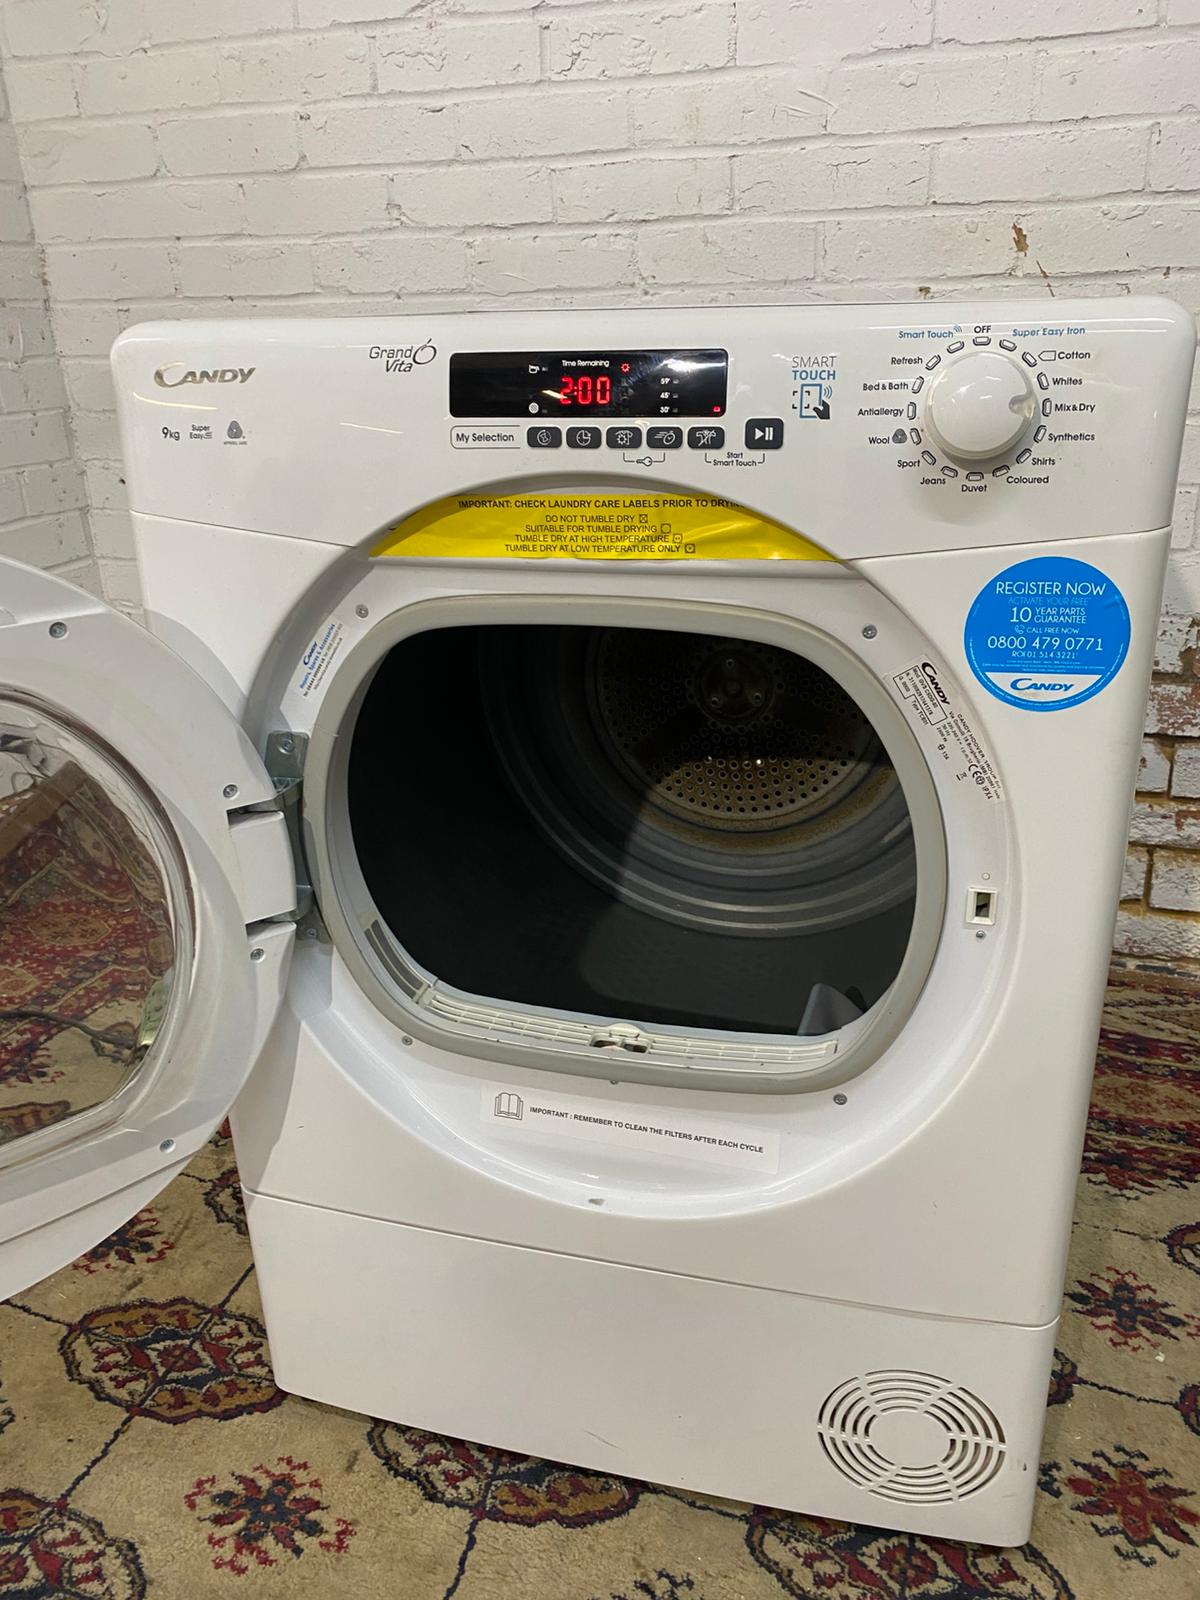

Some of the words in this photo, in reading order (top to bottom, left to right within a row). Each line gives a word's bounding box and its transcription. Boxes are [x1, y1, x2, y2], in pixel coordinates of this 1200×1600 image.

[898, 330, 925, 339] Smart
[927, 330, 953, 338] Touch
[974, 325, 991, 334] OFF
[1012, 328, 1040, 337] Super
[1042, 327, 1064, 337] Easy
[1067, 326, 1086, 335] Iron
[369, 346, 413, 359] Grand
[1057, 351, 1091, 360] Cotton
[386, 359, 413, 372] Vita
[577, 359, 609, 368] Remaining
[792, 355, 837, 368] SMART
[890, 356, 923, 365] Refresh
[154, 362, 256, 388] CANDY
[792, 370, 836, 380] TOUCH
[863, 382, 880, 391] Bed
[888, 381, 908, 390] Bath
[1052, 377, 1083, 386] Whites
[560, 376, 610, 405] 2:00
[857, 407, 905, 418] Antiallergy
[1054, 402, 1096, 413] Mix&Dry
[191, 424, 210, 432] Super
[162, 426, 181, 441] 9kg
[189, 431, 204, 440] Easy
[456, 433, 470, 444] My
[471, 432, 514, 443] Selection
[1048, 432, 1096, 442] Synthetics
[868, 436, 890, 445] Wool
[726, 451, 743, 459] Start
[712, 459, 734, 467] Smart
[735, 459, 757, 467] Touch
[897, 459, 921, 469] Sport
[1031, 457, 1056, 466] Shirts
[920, 476, 946, 486] Jeans
[1006, 475, 1049, 485] Coloured
[961, 484, 988, 493] Duvet
[458, 500, 513, 508] IMPORTANT:
[514, 499, 546, 508] CHECK
[548, 499, 592, 508] LAUNDRY
[594, 499, 620, 508] CARE
[622, 499, 660, 508] LABELS
[662, 499, 693, 508] PRIOR
[695, 499, 708, 507] TO
[545, 514, 559, 522] DO
[560, 514, 578, 523] NOT
[579, 514, 614, 523] TUMBLE
[616, 514, 635, 523] DRY
[525, 524, 564, 533] SUITABLE
[566, 524, 585, 533] FOR
[587, 524, 621, 533] TUMBLE
[623, 524, 658, 533] DRYING
[515, 534, 548, 543] TUMBLE
[550, 534, 568, 543] DRY
[569, 534, 579, 543] AT
[581, 535, 603, 543] HIGH
[605, 535, 670, 543] TEMPERATURE
[505, 543, 537, 552] TUMBLE
[539, 543, 558, 552] DRY
[559, 544, 569, 552] AT
[570, 544, 590, 553] LOW
[592, 544, 656, 553] TEMPERATURE
[657, 544, 681, 553] ONLY
[995, 581, 1062, 595] REGISTER
[1065, 582, 1107, 596] NOW
[1010, 606, 1032, 623] 10
[1035, 607, 1058, 615] YEAR
[1059, 607, 1086, 616] PARTS
[1033, 615, 1087, 624] GUARANTEE
[1026, 626, 1042, 634] CALL
[987, 635, 1027, 649] 0800
[1032, 636, 1060, 650] 479
[1064, 637, 1103, 651] 0771
[921, 662, 950, 705] CANDY
[1010, 677, 1075, 692] CANDY
[529, 1106, 569, 1119] IMPORTANT
[573, 1113, 613, 1127] REMEMBER
[614, 1120, 624, 1129] TO
[624, 1122, 648, 1133] CLEAN
[649, 1127, 664, 1136] THE
[664, 1129, 693, 1141] FILTERS
[693, 1135, 717, 1145] AFTER
[718, 1138, 739, 1149] EACH
[739, 1143, 764, 1154] CYCLE
